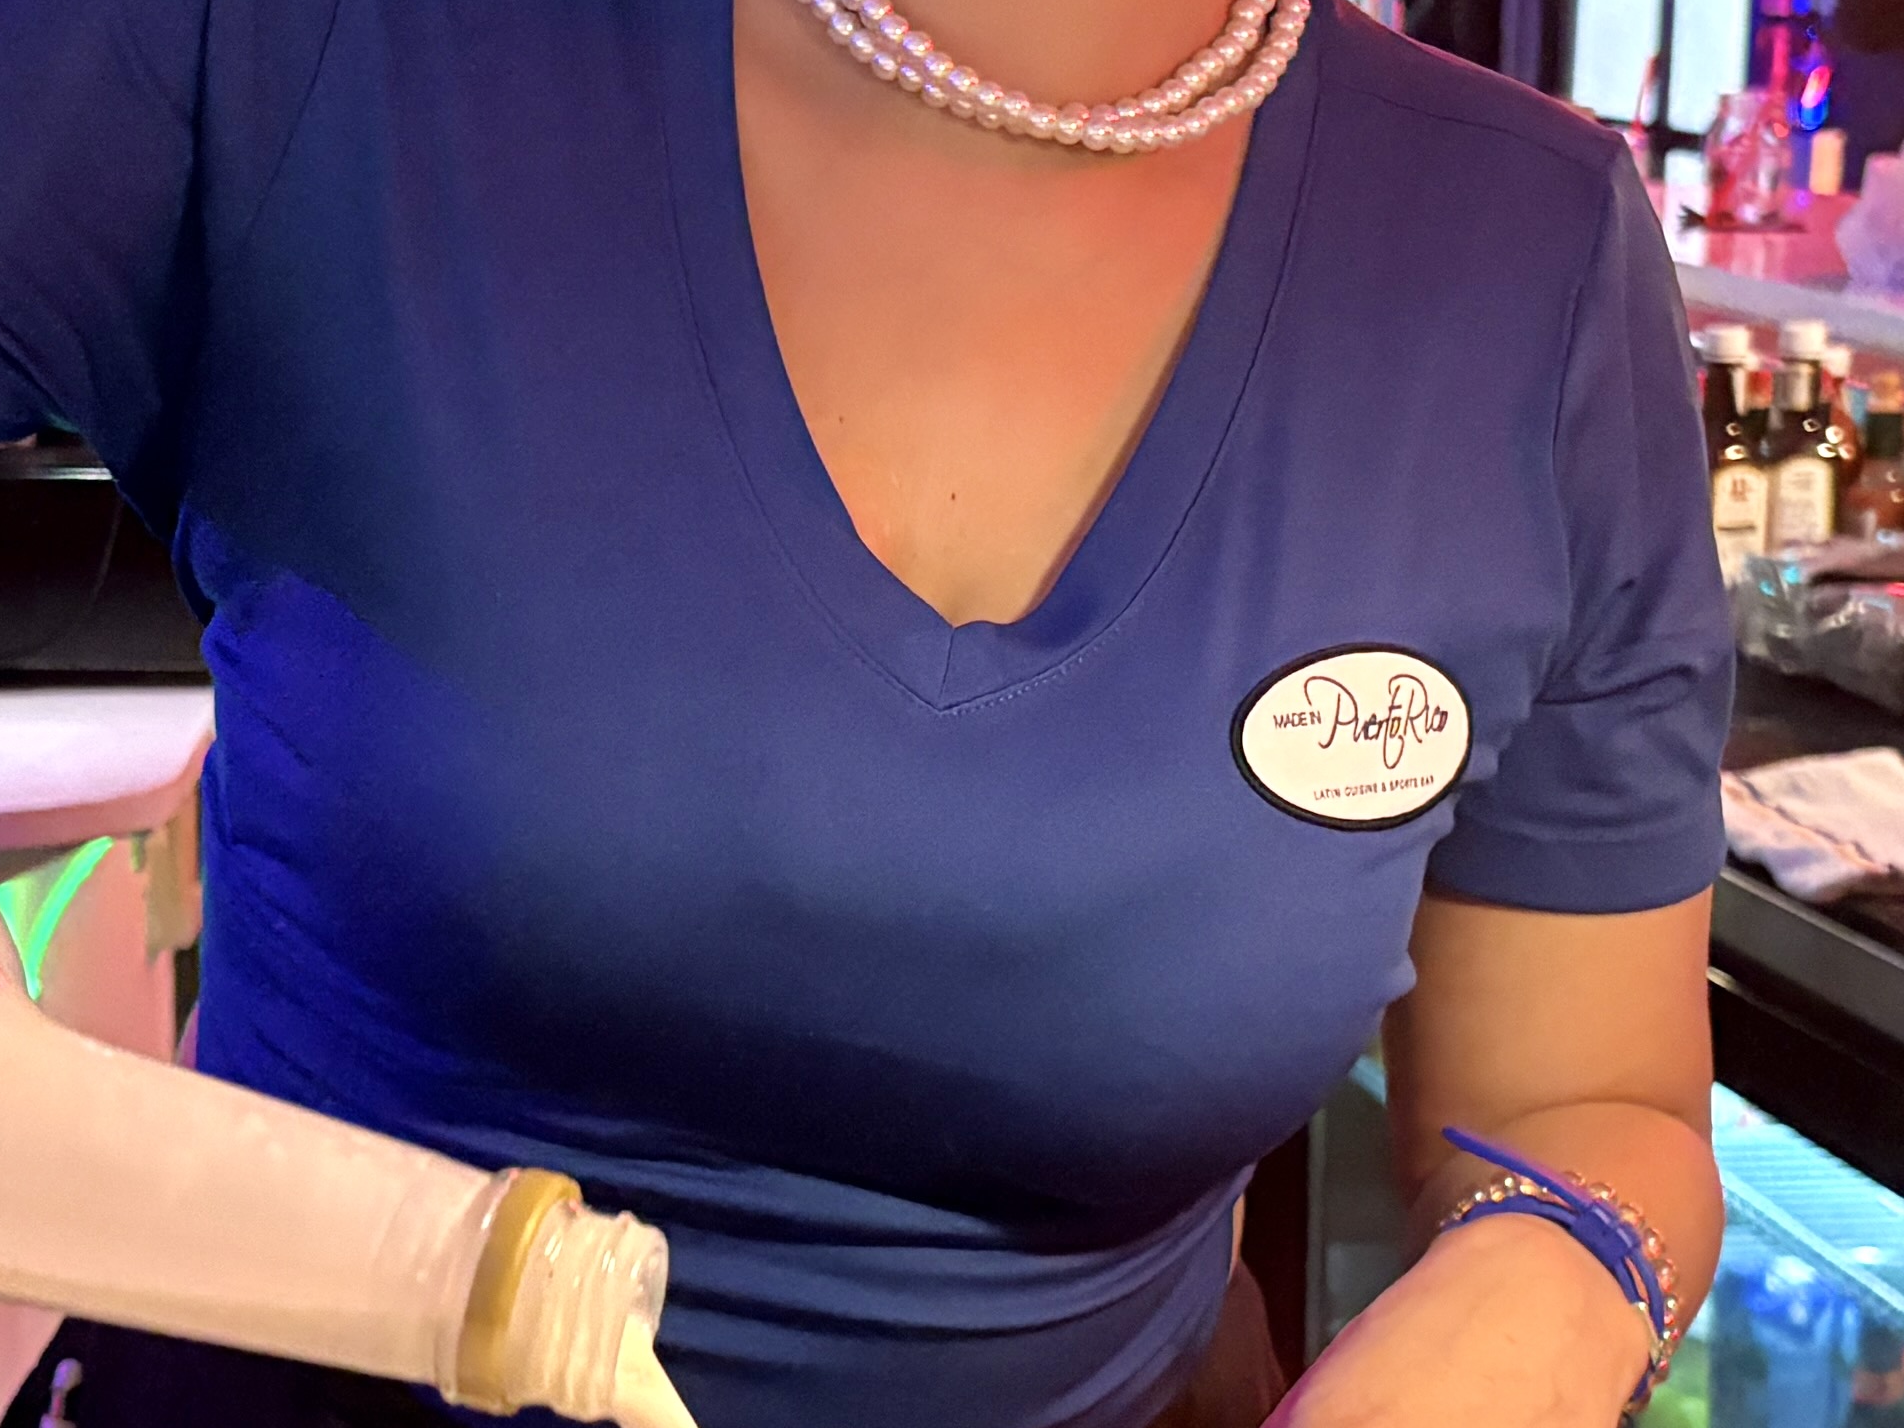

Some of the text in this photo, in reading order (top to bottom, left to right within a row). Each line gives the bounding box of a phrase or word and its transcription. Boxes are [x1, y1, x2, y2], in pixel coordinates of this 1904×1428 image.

[1273, 712, 1308, 729] MADE
[1309, 710, 1322, 725] IN
[1313, 788, 1341, 801] LATIN
